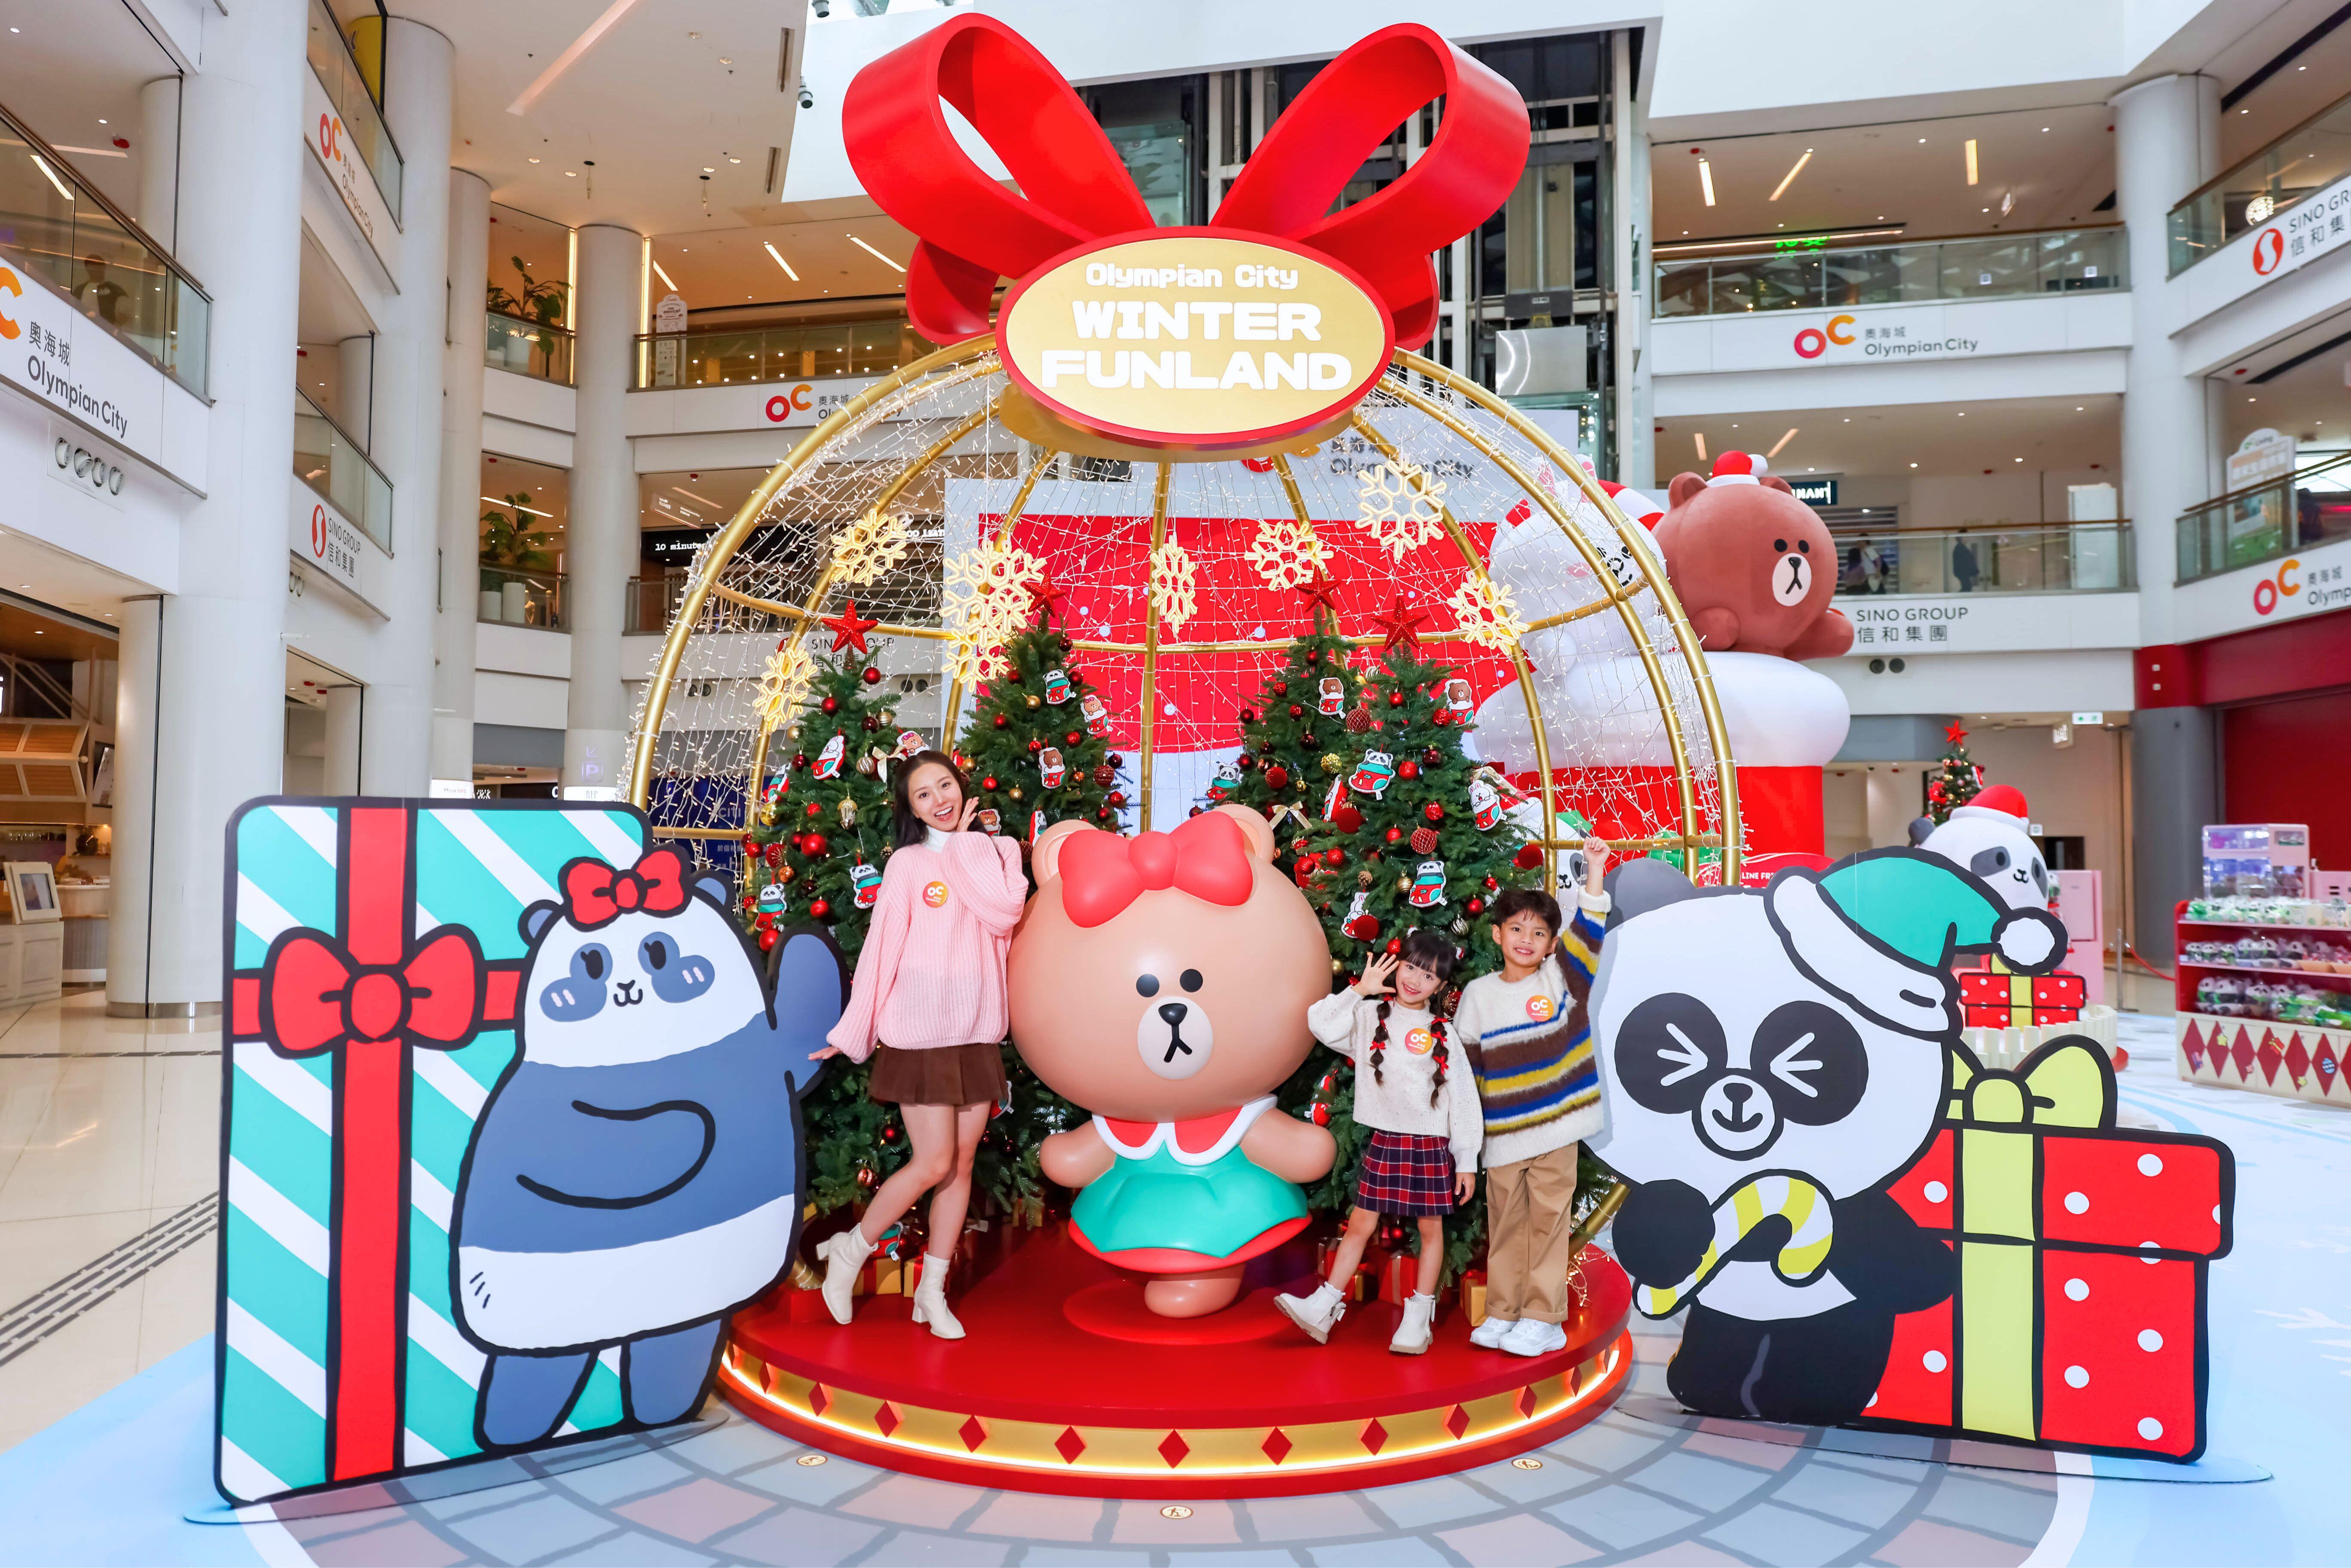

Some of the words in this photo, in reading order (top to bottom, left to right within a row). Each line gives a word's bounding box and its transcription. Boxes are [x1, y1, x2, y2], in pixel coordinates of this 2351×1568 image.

[319, 113, 342, 162] OC
[2289, 204, 2324, 234] SINO
[2329, 189, 2351, 211] GR
[2290, 214, 2351, 258] 信和集
[1085, 263, 1222, 289] Olympian
[1234, 264, 1299, 289] City
[1072, 300, 1322, 341] WINTER
[1794, 315, 1856, 359] OC
[1041, 349, 1352, 391] FUNLAND
[765, 384, 813, 422] OC
[328, 517, 342, 541] SINO
[343, 529, 361, 555] GROUP
[2254, 559, 2301, 616] OC
[1857, 609, 1899, 622] SINO
[1905, 607, 1968, 620] GROUP
[811, 639, 834, 649] SIN
[1858, 625, 1947, 643] 信和集團
[718, 806, 741, 817] citi
[927, 886, 944, 896] OC
[1531, 999, 1548, 1011] OC
[1410, 1033, 1428, 1042] OC
